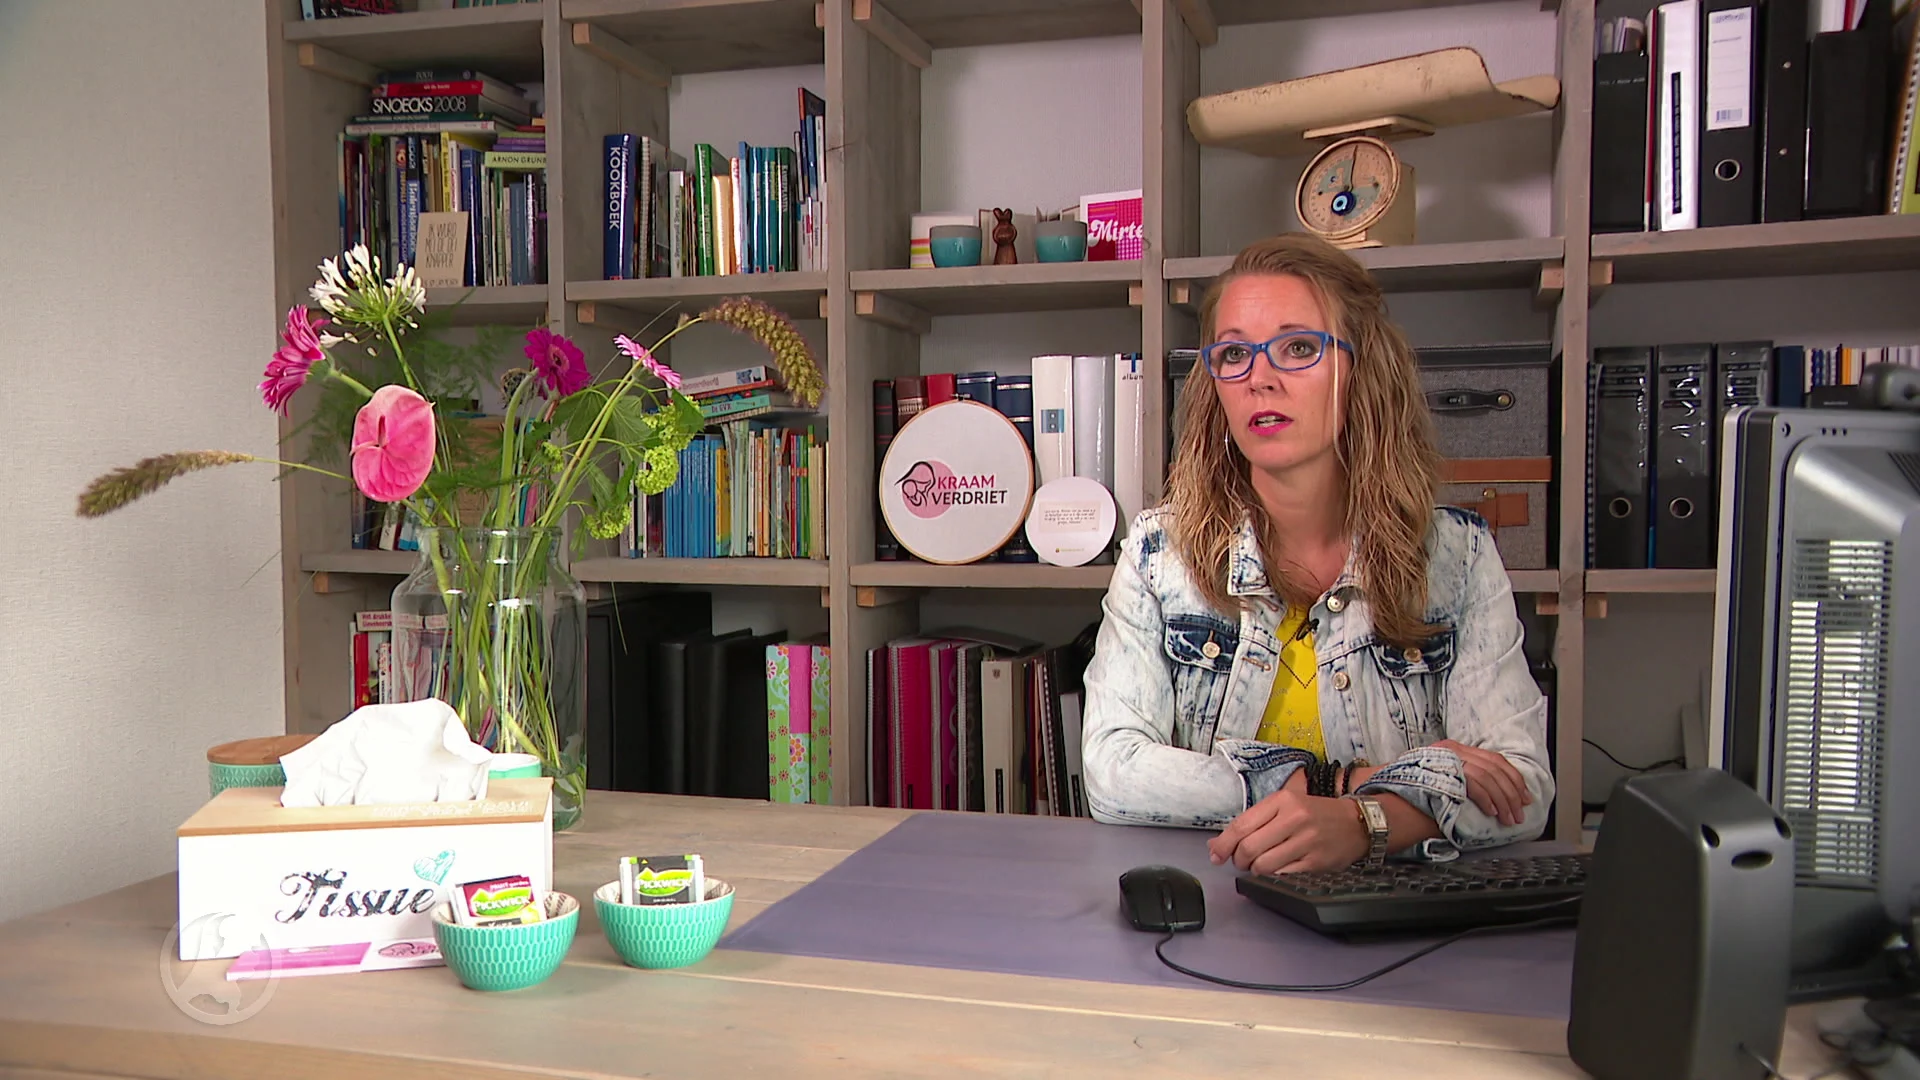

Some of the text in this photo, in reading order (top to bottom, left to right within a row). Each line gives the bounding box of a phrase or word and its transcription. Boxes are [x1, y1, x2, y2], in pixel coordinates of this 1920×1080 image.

[372, 96, 467, 113] SNOECKS 2008
[493, 156, 519, 164] ARNON
[609, 146, 621, 230] KOOKBOEK
[1088, 219, 1143, 247] Mirte
[937, 474, 995, 491] KRAAM
[931, 489, 1008, 506] VERDRIET
[638, 879, 692, 889] PICKWICK
[275, 868, 437, 924] Tissue
[474, 895, 531, 911] PICKWICK
